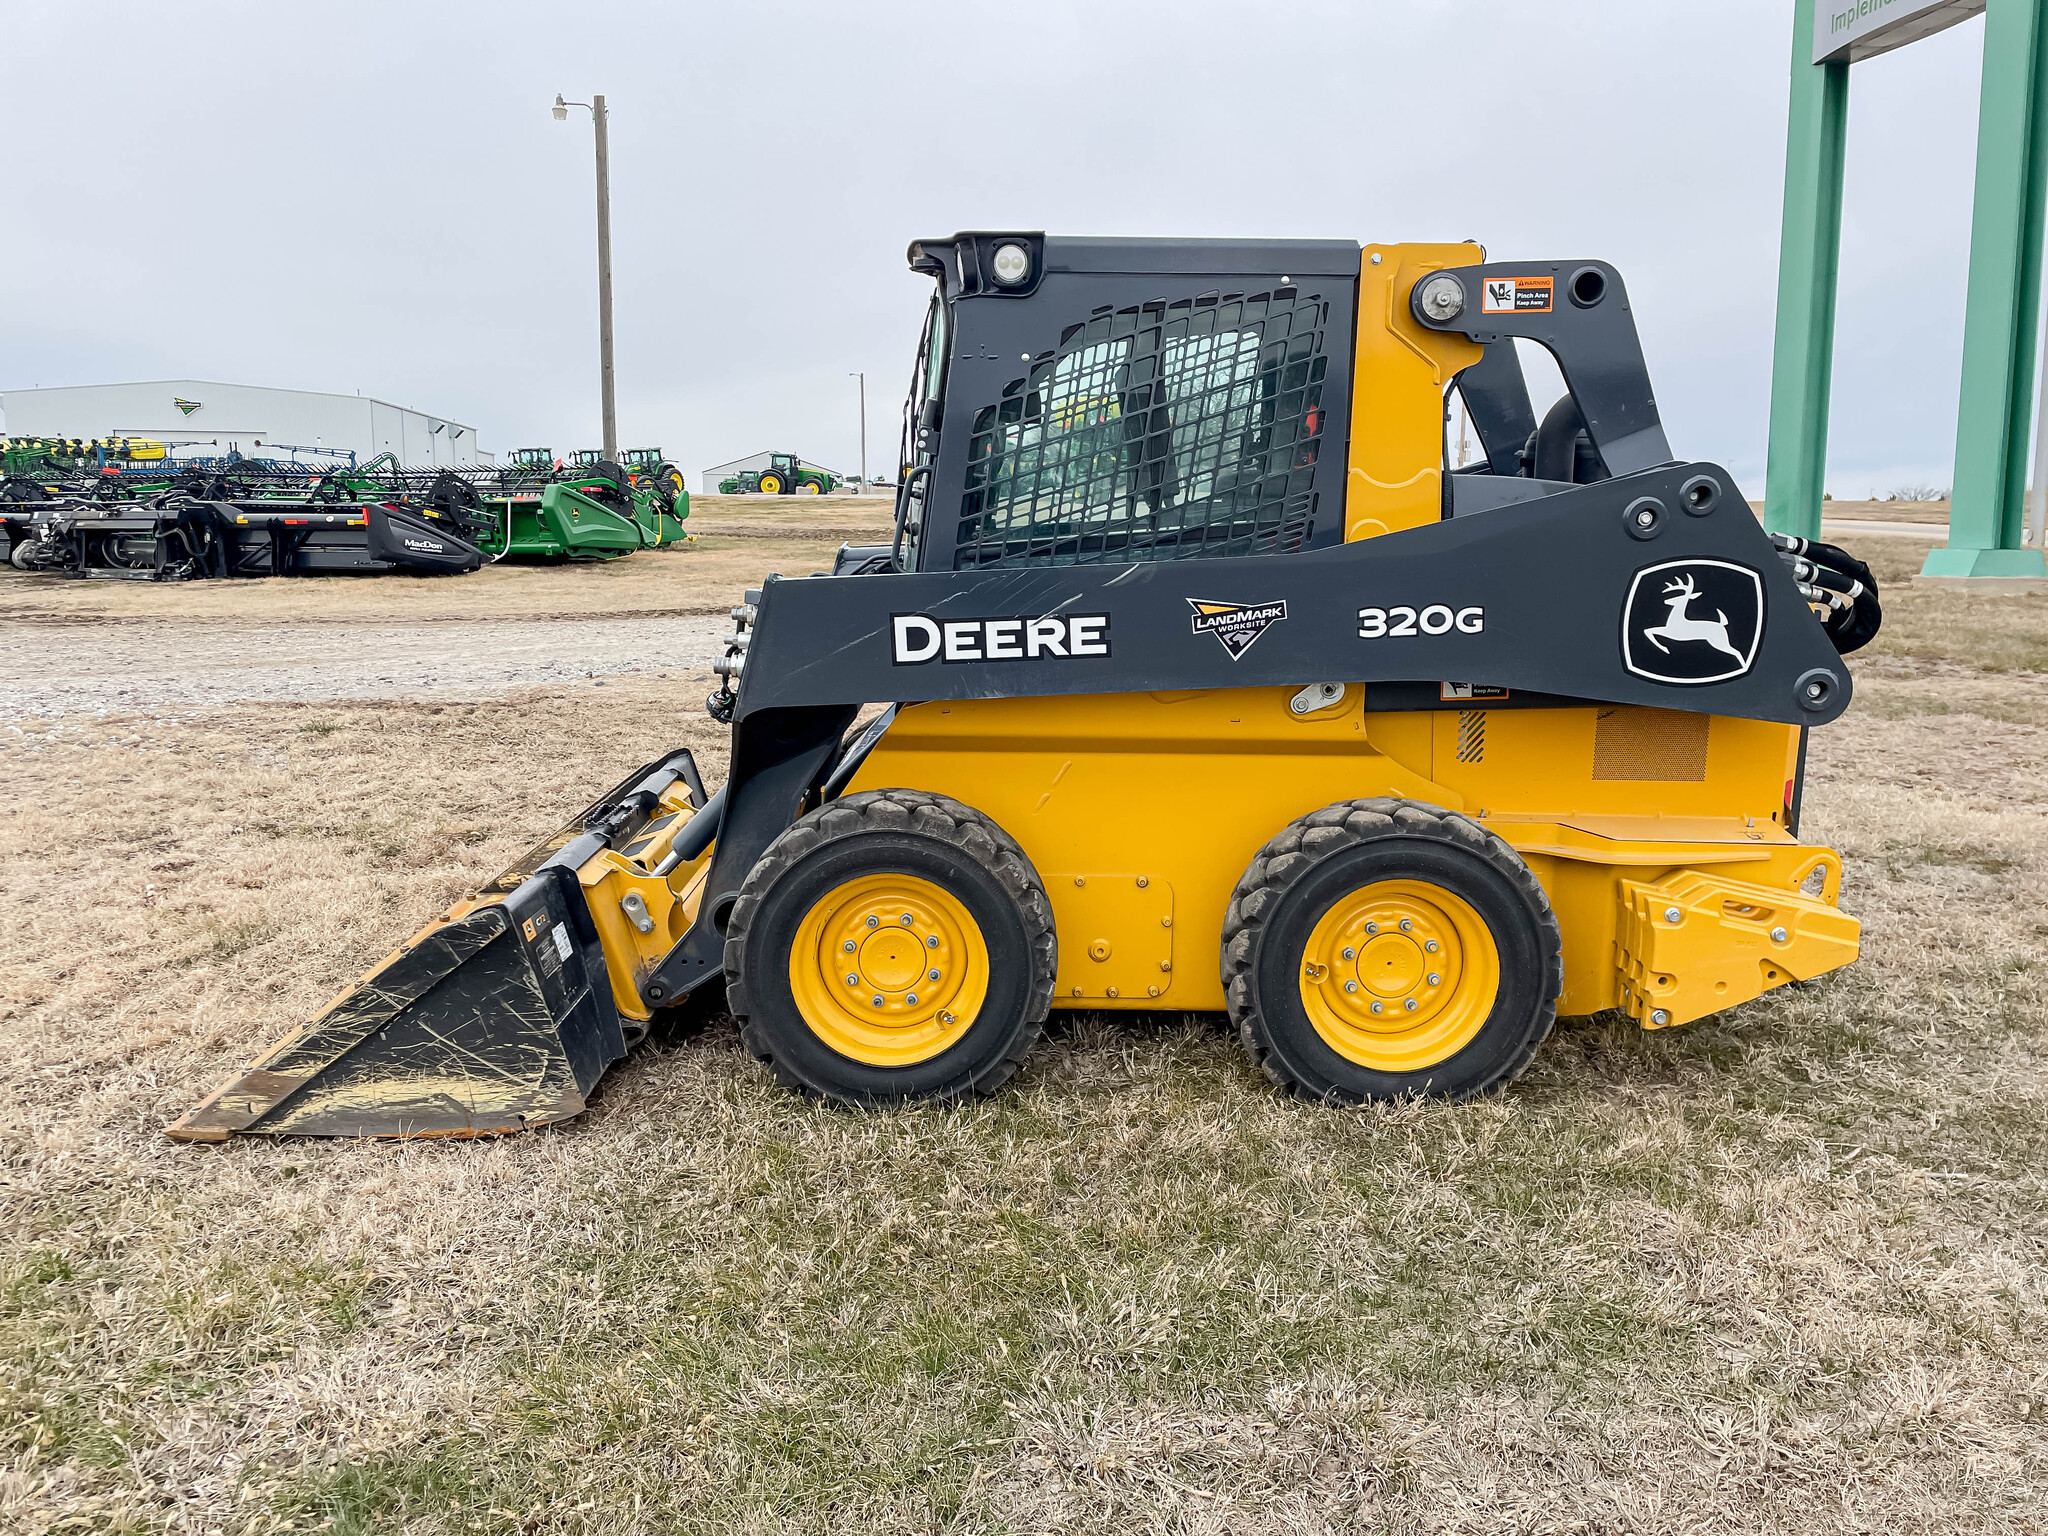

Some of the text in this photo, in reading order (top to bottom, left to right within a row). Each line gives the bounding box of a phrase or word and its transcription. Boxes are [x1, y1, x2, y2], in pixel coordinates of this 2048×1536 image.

[404, 539, 443, 549] MacDon
[1196, 606, 1283, 629] LANDMARK
[1218, 619, 1266, 632] WORKSITE
[1359, 604, 1483, 638] 320G
[893, 616, 1107, 662] DEERE
